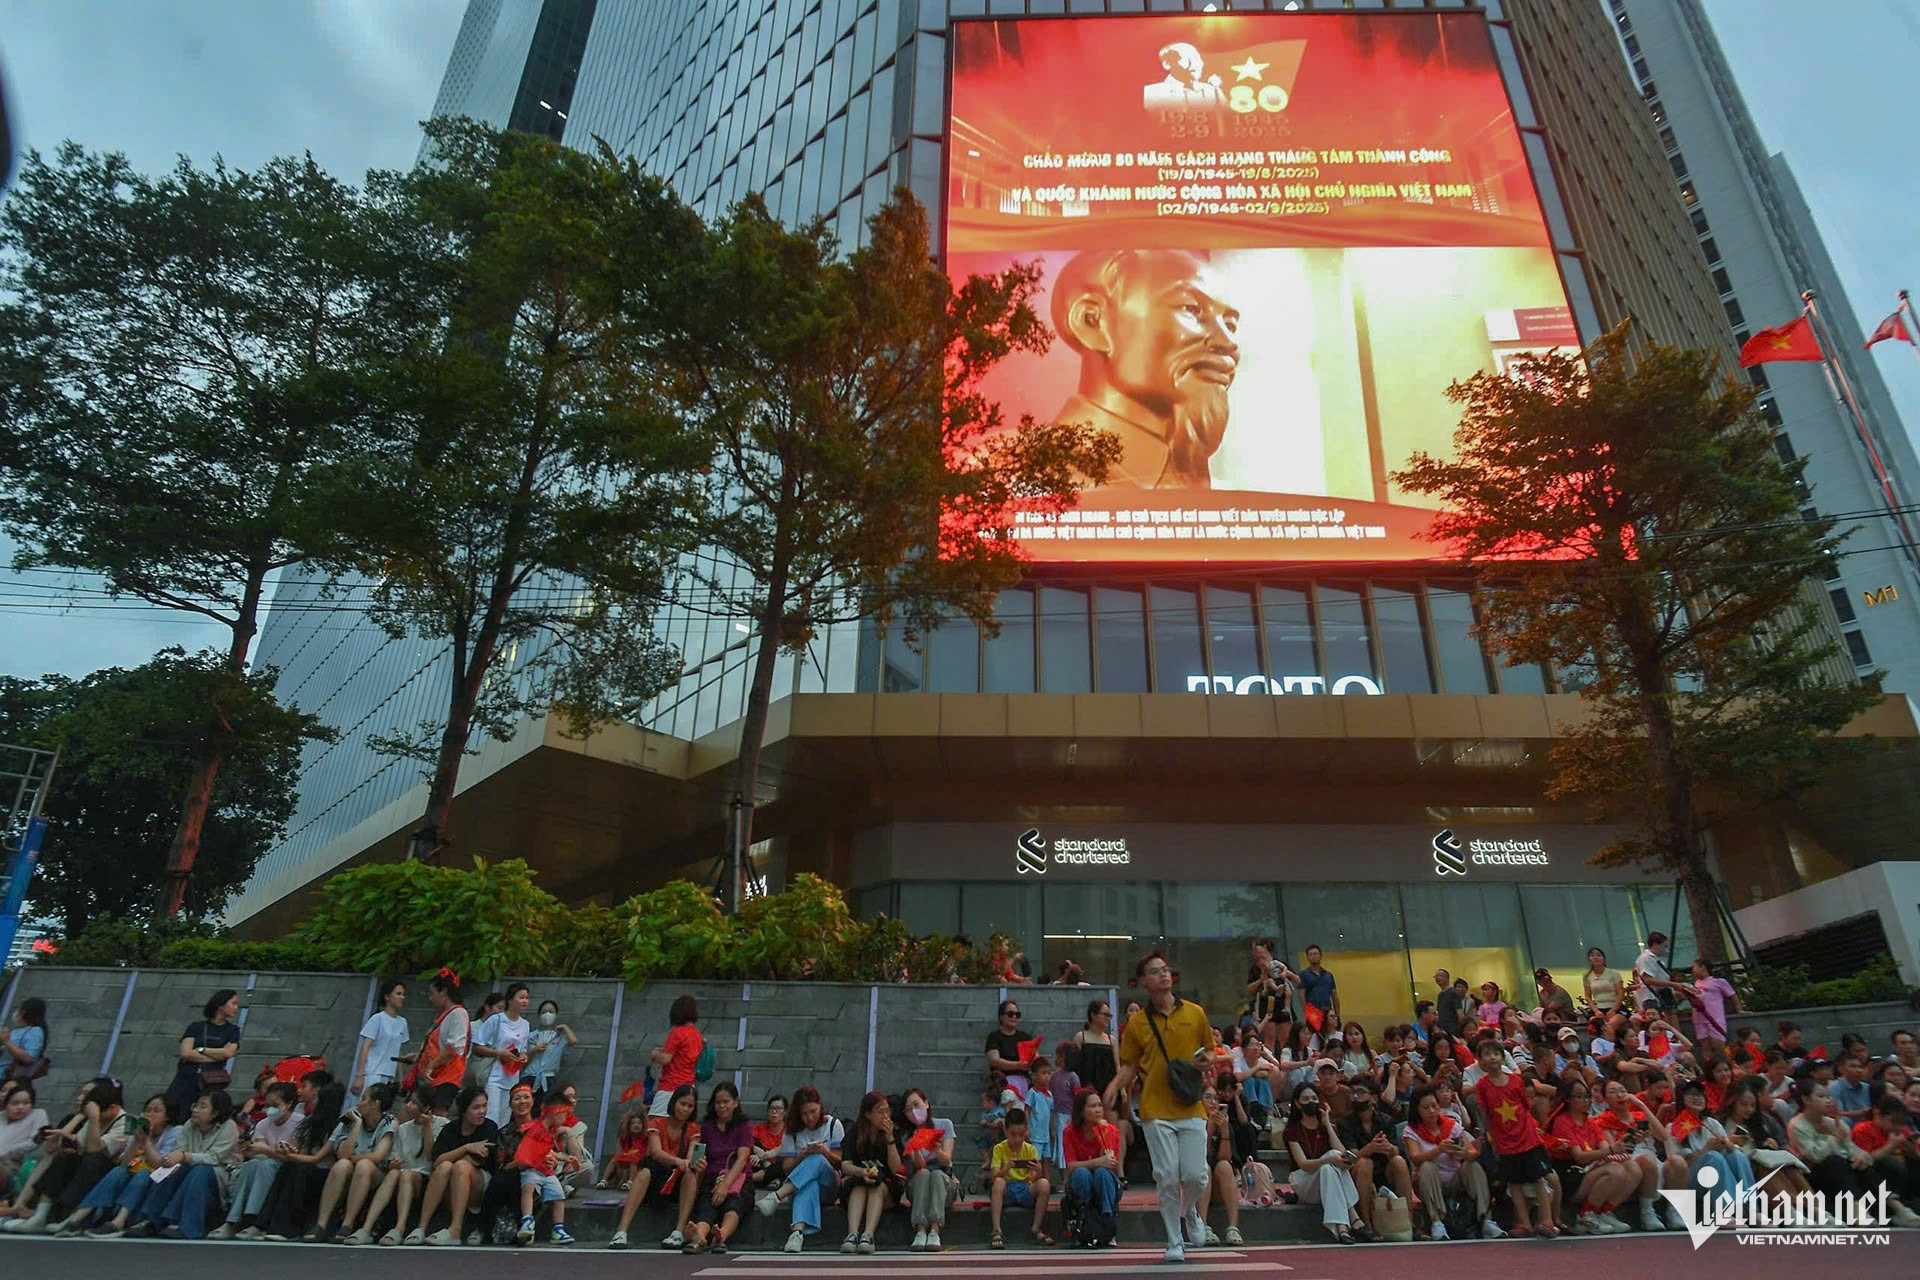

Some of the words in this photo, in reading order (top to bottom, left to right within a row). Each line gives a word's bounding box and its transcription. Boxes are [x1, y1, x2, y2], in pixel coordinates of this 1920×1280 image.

[1229, 85, 1288, 113] 80
[1187, 675, 1385, 695] TOTO
[1054, 838, 1126, 851] standard
[1469, 839, 1542, 852] standard
[1054, 850, 1130, 864] chartered
[1471, 851, 1549, 865] chartered
